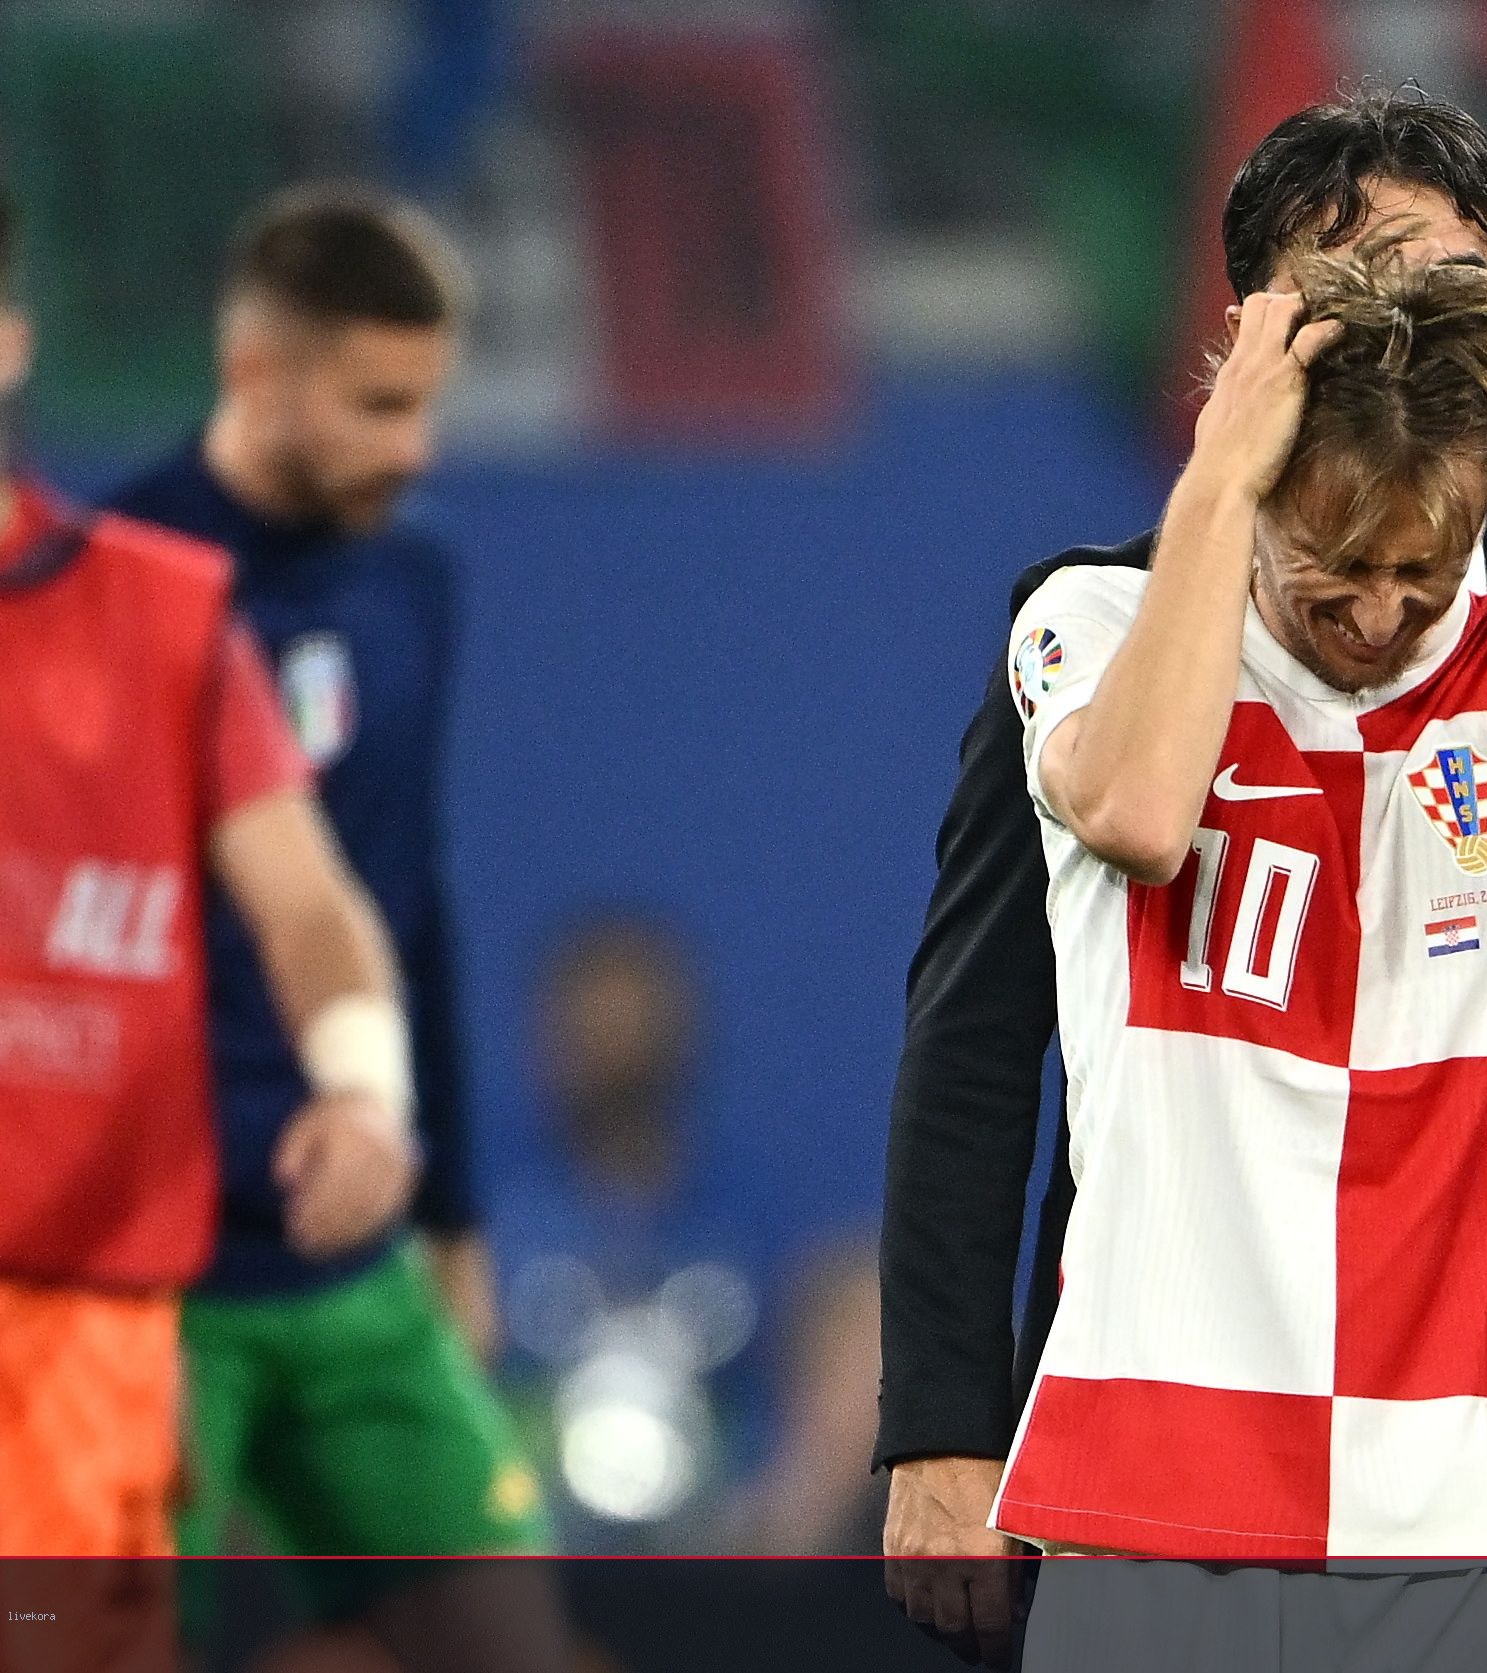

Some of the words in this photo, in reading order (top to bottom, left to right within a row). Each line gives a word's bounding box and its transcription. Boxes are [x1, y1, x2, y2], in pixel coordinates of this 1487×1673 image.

[1447, 756, 1473, 822] HNS
[1180, 827, 1320, 1012] 10
[1430, 892, 1479, 911] LEIPZIG,
